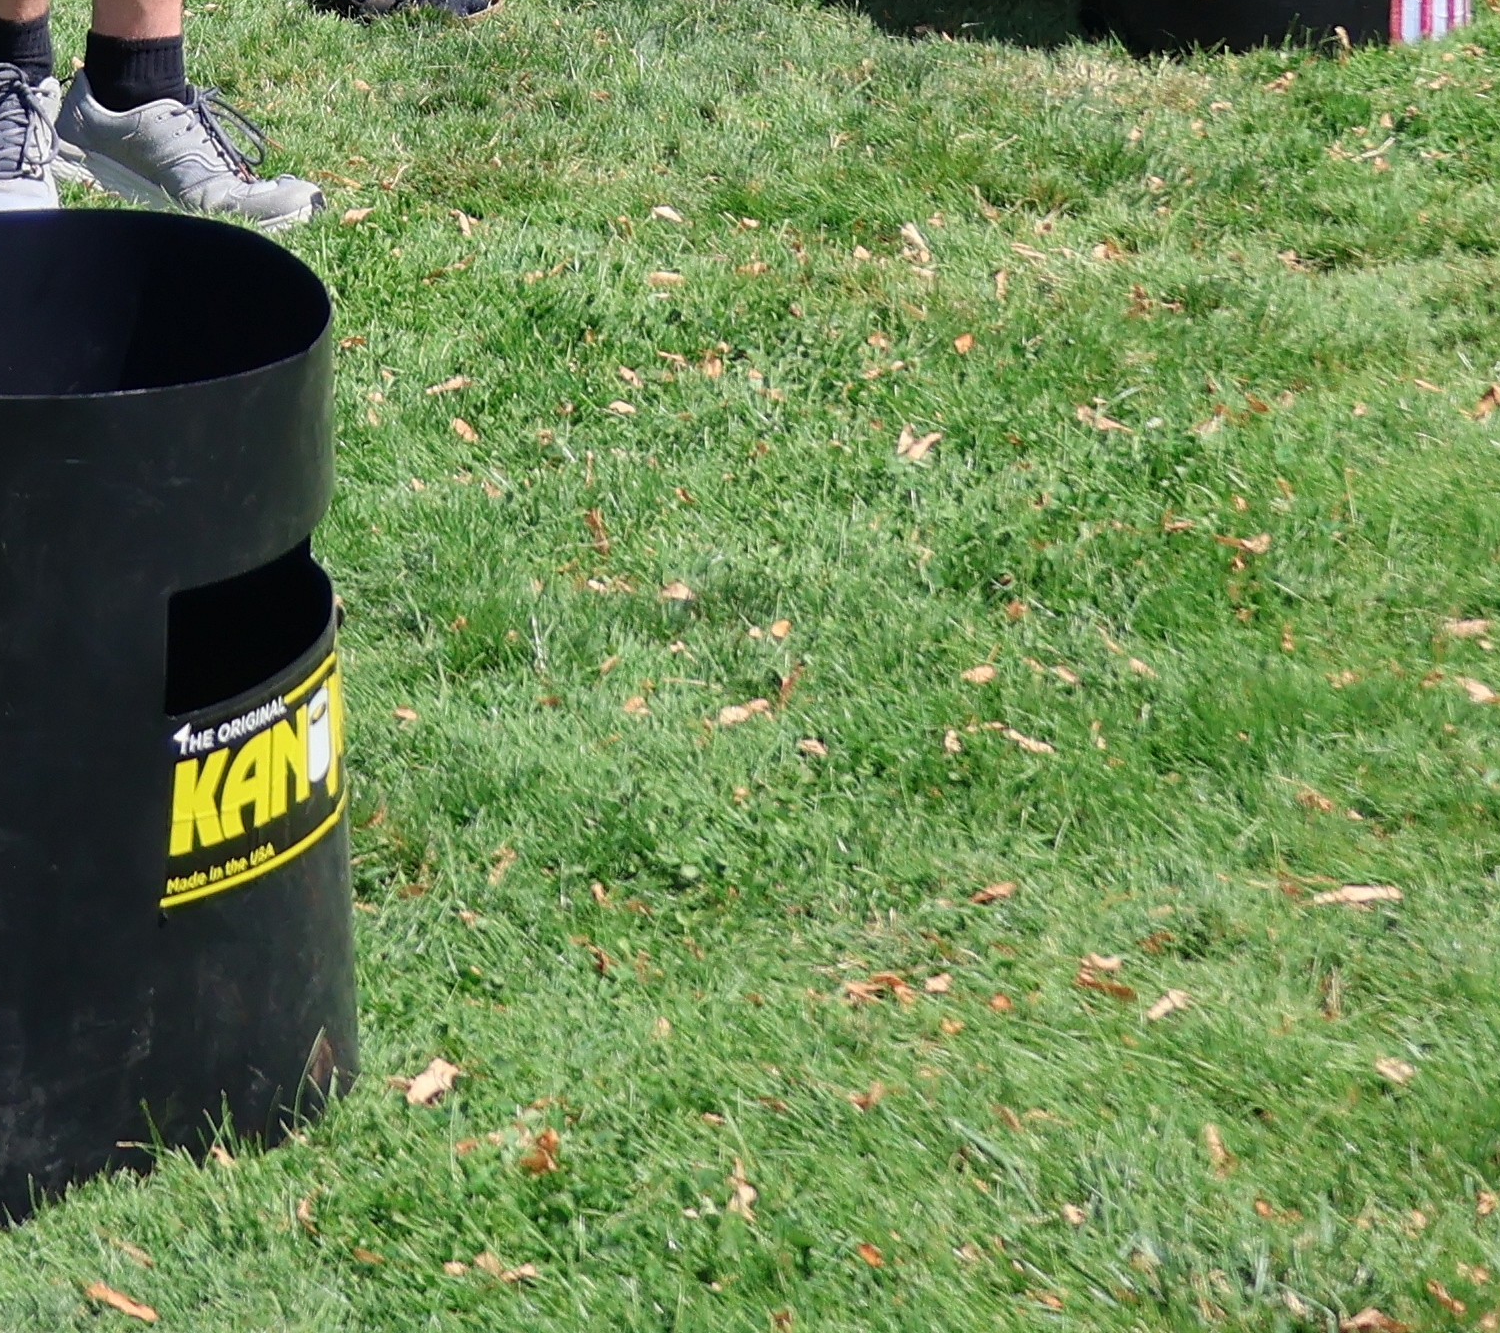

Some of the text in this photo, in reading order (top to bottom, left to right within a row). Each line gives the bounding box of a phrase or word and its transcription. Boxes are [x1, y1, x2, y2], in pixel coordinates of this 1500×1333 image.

[173, 695, 288, 755] THE ORIGINAL
[166, 841, 276, 894] Made in the USA
